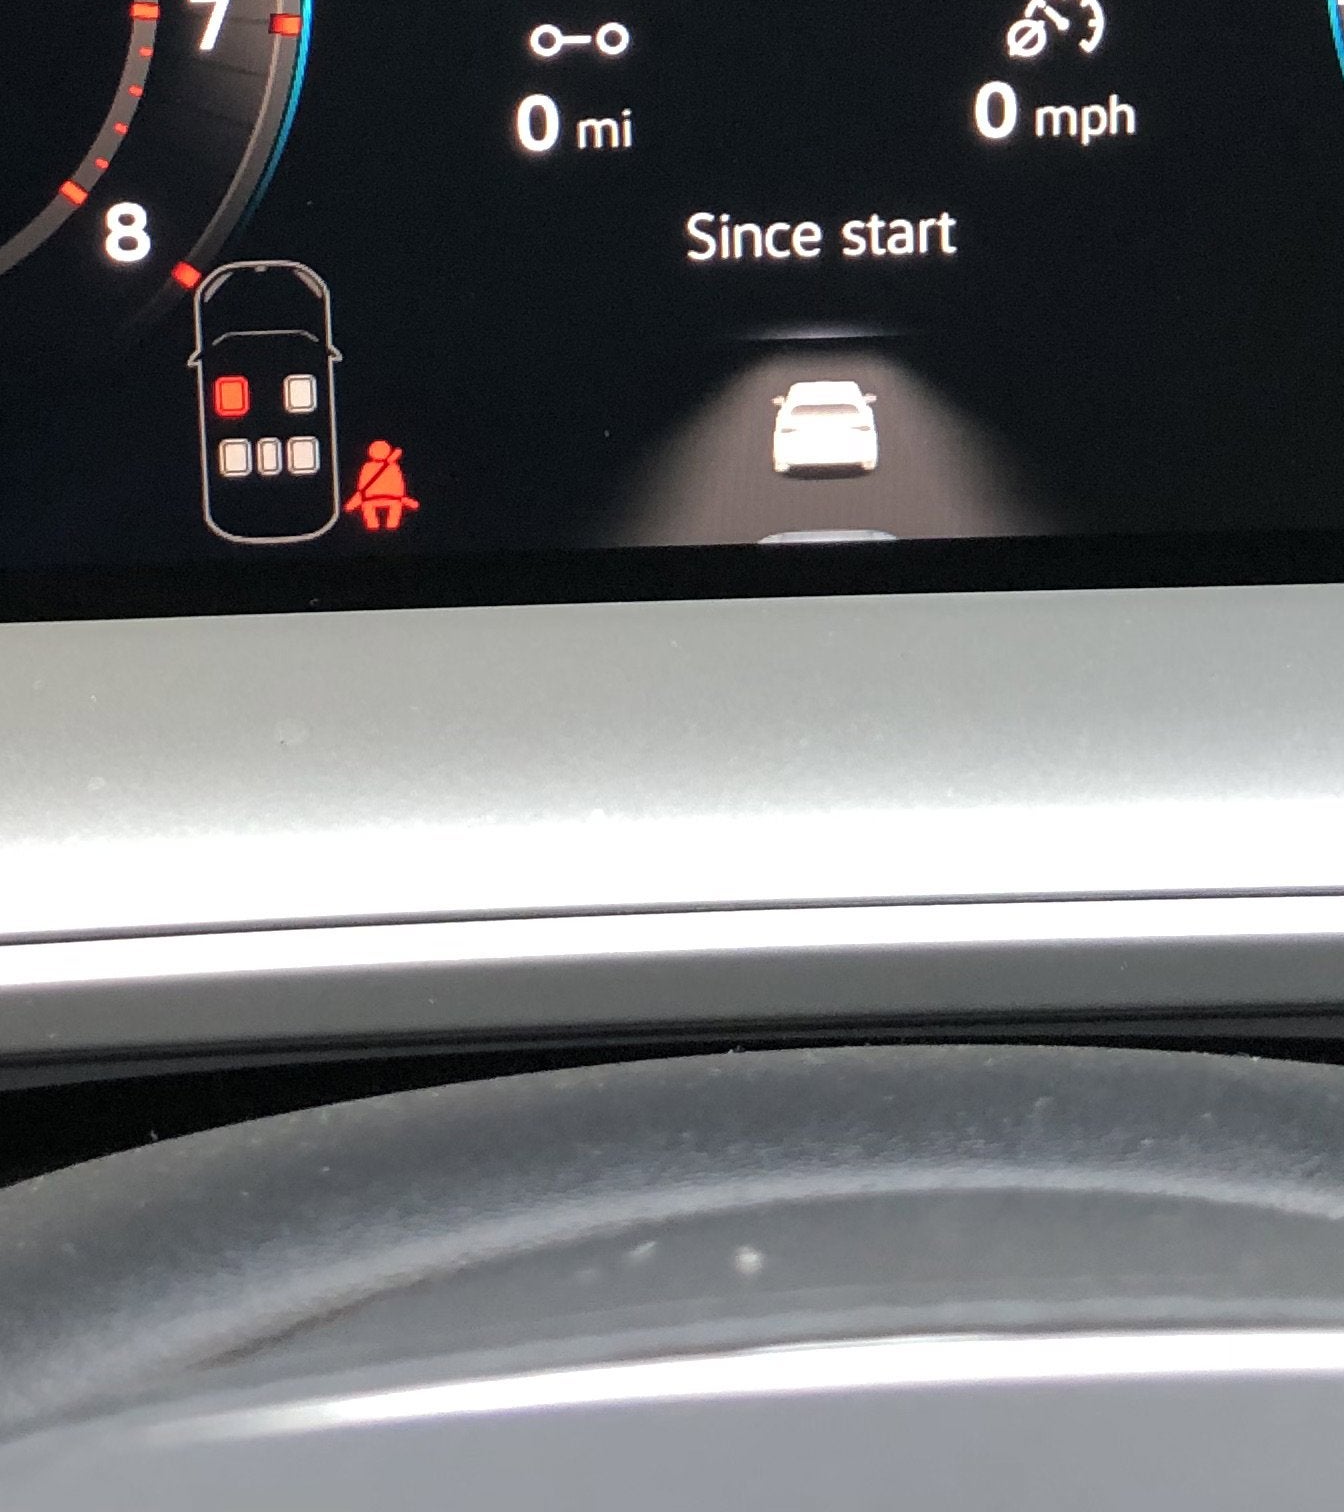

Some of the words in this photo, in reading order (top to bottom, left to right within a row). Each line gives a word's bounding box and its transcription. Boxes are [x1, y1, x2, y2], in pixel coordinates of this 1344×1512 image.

[515, 93, 560, 153] 0
[576, 108, 632, 150] mi
[973, 80, 1018, 140] 0
[1035, 93, 1136, 147] mph
[103, 201, 152, 264] 8
[686, 212, 823, 261] Since
[841, 211, 958, 257] start
